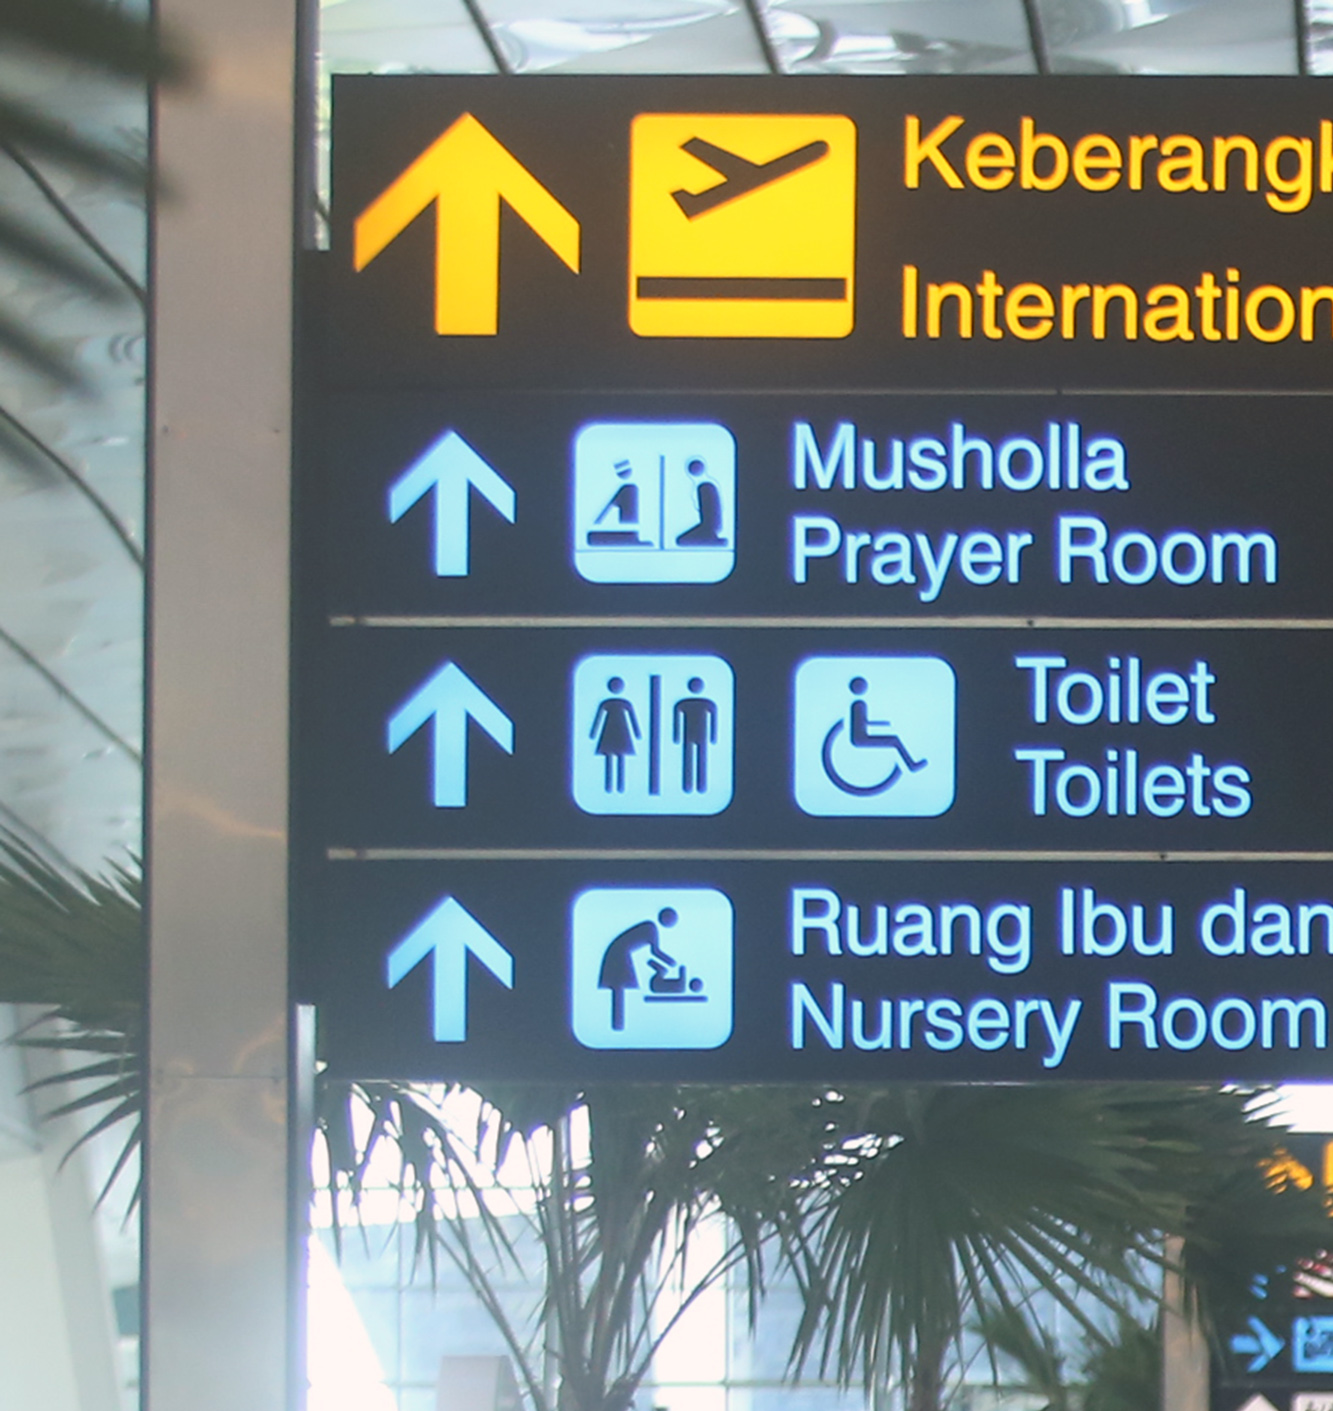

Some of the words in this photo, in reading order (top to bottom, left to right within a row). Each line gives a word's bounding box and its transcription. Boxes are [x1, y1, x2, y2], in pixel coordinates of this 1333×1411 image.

[788, 419, 1130, 491] Musholla
[787, 511, 1034, 602] Prayer
[1054, 511, 1277, 585] Room
[1012, 651, 1216, 726] Toilet
[1010, 743, 1252, 818] Toilets
[785, 883, 1032, 974] Ruang
[1057, 884, 1174, 956] Ibu
[786, 980, 1083, 1068] Nursery
[1105, 981, 1327, 1051] Room
